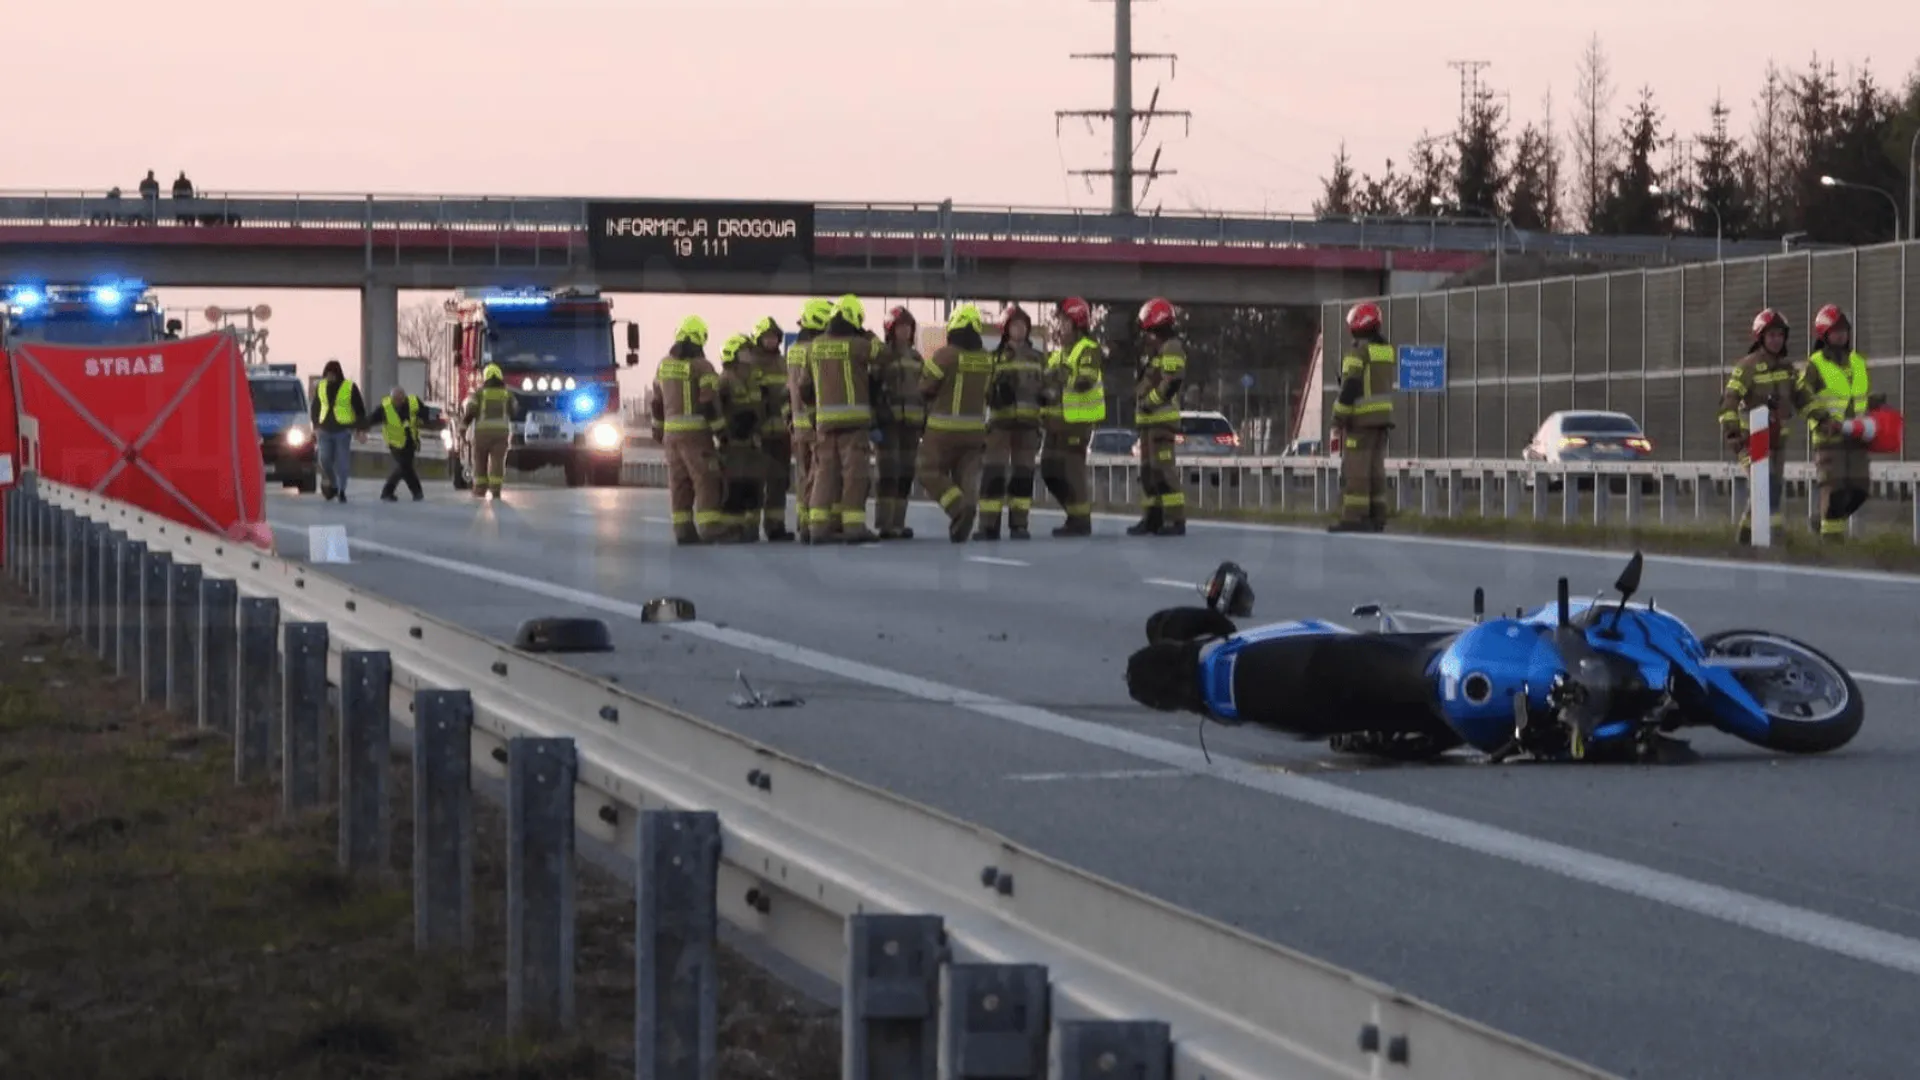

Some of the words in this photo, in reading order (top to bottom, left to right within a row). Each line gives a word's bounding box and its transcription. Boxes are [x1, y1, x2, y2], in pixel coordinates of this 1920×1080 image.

[606, 218, 707, 237] INFORMACJA
[718, 218, 796, 237] DROGOWA
[674, 238, 692, 256] 19
[702, 238, 728, 256] 111
